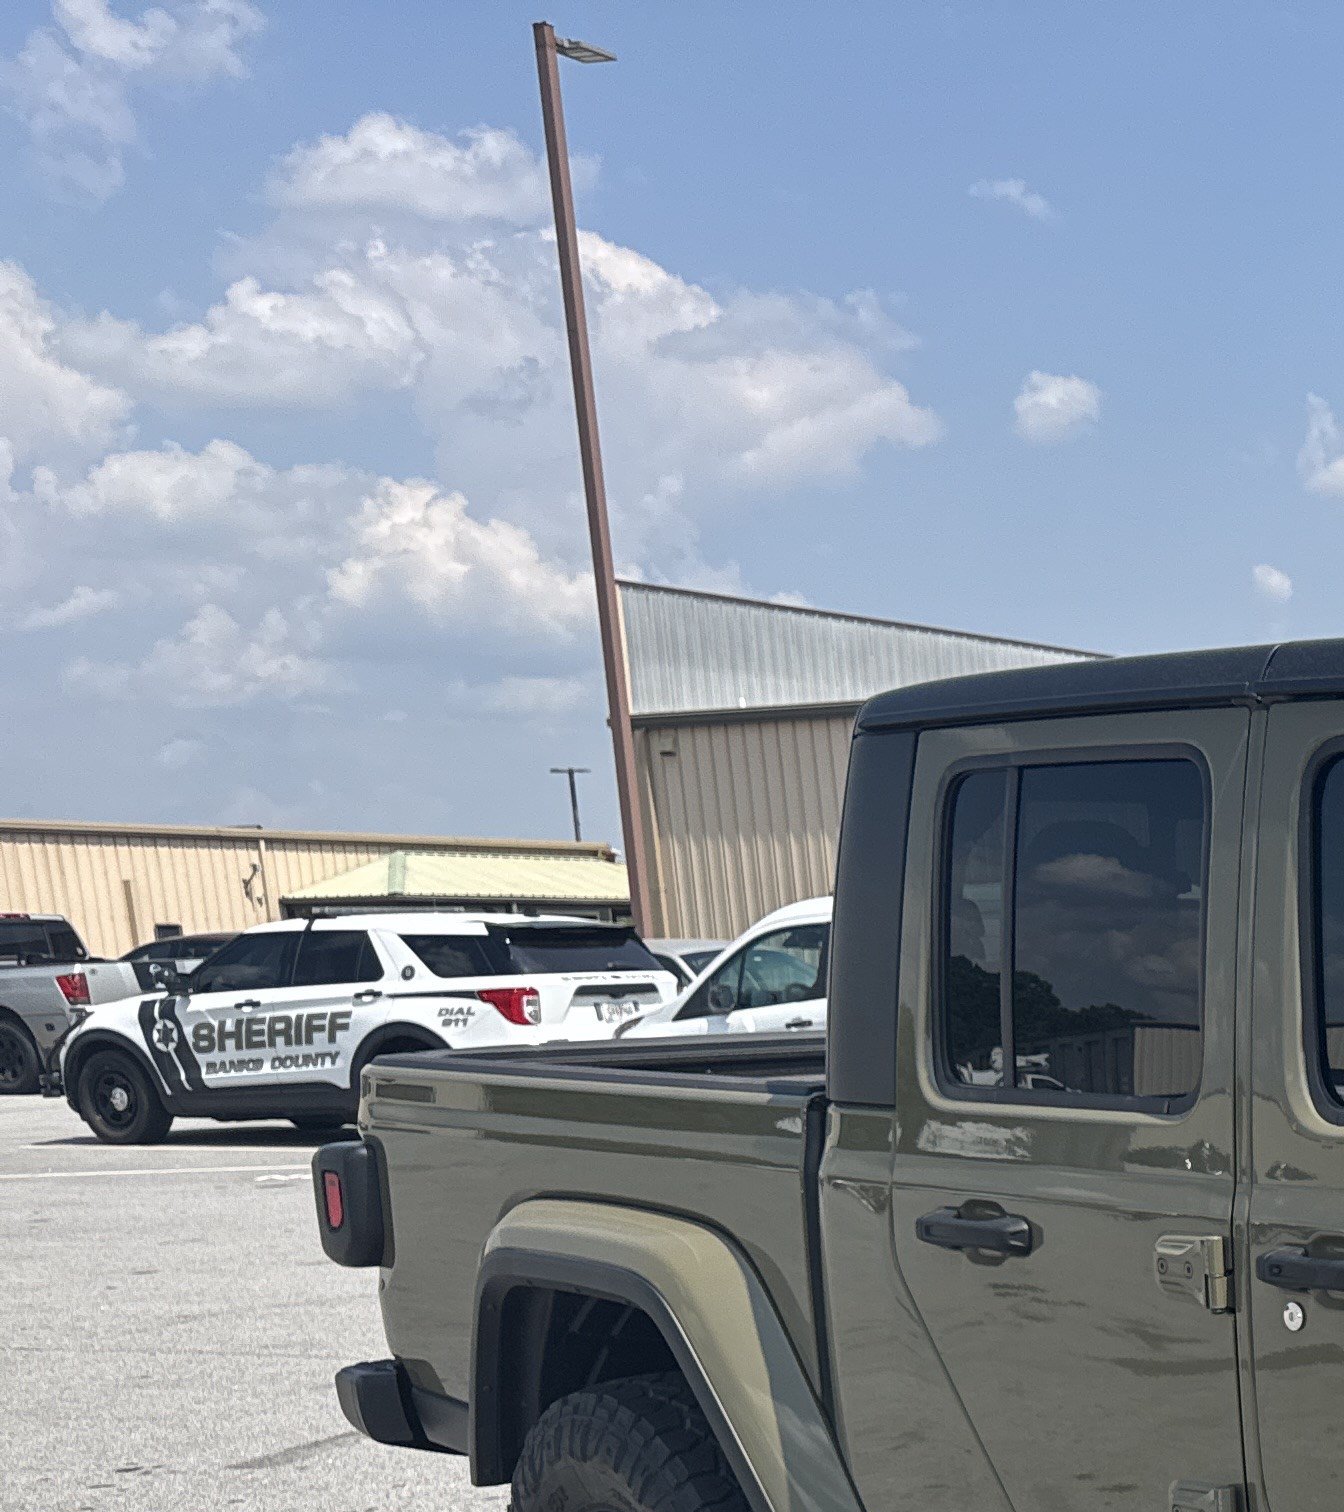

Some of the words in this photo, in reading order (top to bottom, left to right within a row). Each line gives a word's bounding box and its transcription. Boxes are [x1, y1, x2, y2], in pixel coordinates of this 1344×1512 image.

[437, 1006, 475, 1017] DIAL
[441, 1018, 468, 1027] 911
[192, 1011, 352, 1054] SHERIFF
[205, 1058, 264, 1075] BANKS
[270, 1050, 341, 1070] COUNTY
